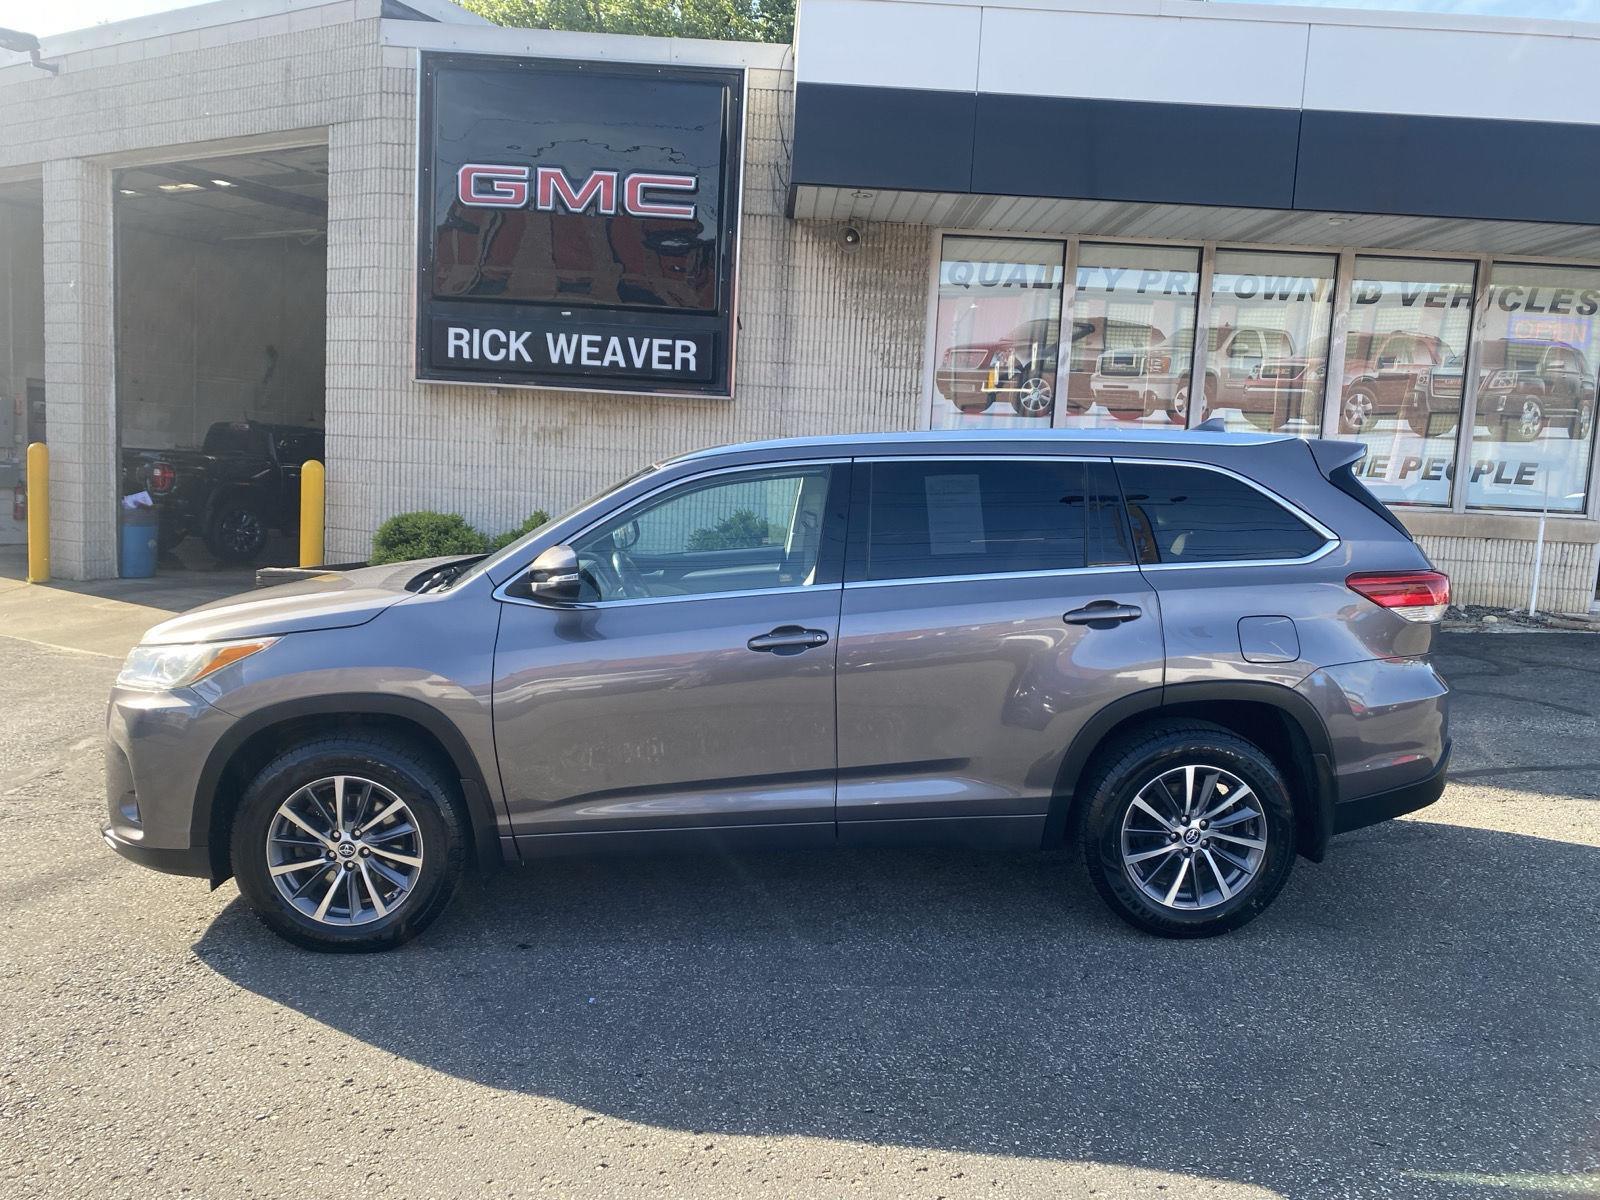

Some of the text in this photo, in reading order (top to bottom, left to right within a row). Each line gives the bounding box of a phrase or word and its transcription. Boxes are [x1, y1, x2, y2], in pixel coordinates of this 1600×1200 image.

[457, 163, 697, 220] GMC
[947, 260, 1129, 292] QUALTY
[1137, 268, 1384, 305] PR-OWND
[447, 327, 697, 371] RICK WEAVER
[1515, 319, 1588, 343] OPEN
[1398, 456, 1540, 486] PEPLE
